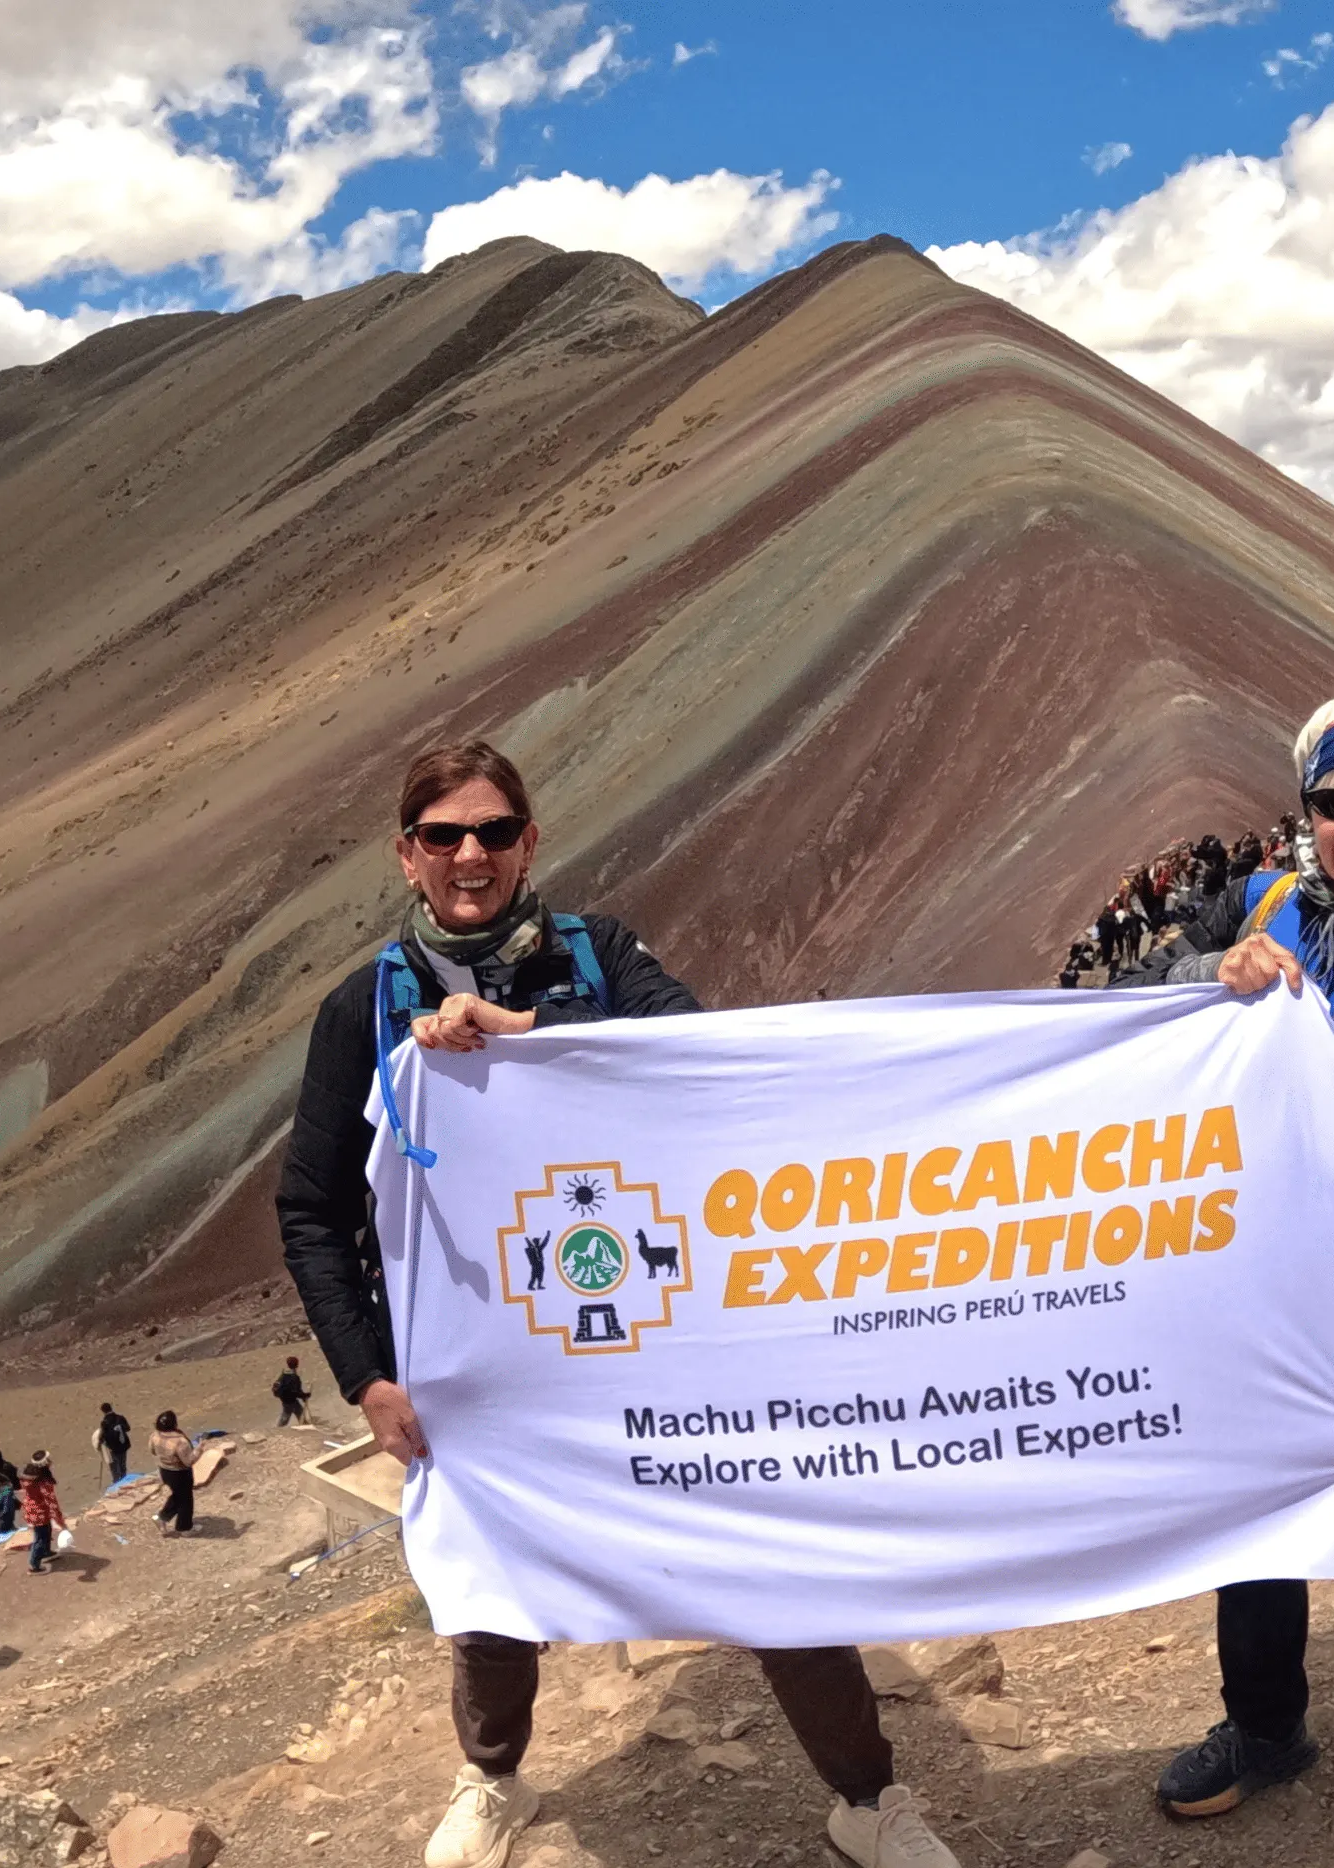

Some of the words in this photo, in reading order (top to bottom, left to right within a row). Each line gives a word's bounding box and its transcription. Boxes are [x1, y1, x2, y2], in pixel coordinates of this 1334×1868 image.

[703, 1105, 1243, 1238] QORICANCHA
[722, 1189, 1238, 1309] EXPEDITIONS
[832, 1303, 957, 1336] INSPIRING
[965, 1288, 1024, 1322] PERÚ
[1032, 1280, 1126, 1313] TRAVELS
[623, 1403, 755, 1439] Machu
[767, 1393, 906, 1432] Picchu
[919, 1376, 1057, 1419] Awaits
[1066, 1366, 1152, 1400] You:
[629, 1453, 781, 1493] Explore
[792, 1442, 879, 1480] with
[891, 1427, 1003, 1471] Local
[1016, 1402, 1182, 1459] Experts!
